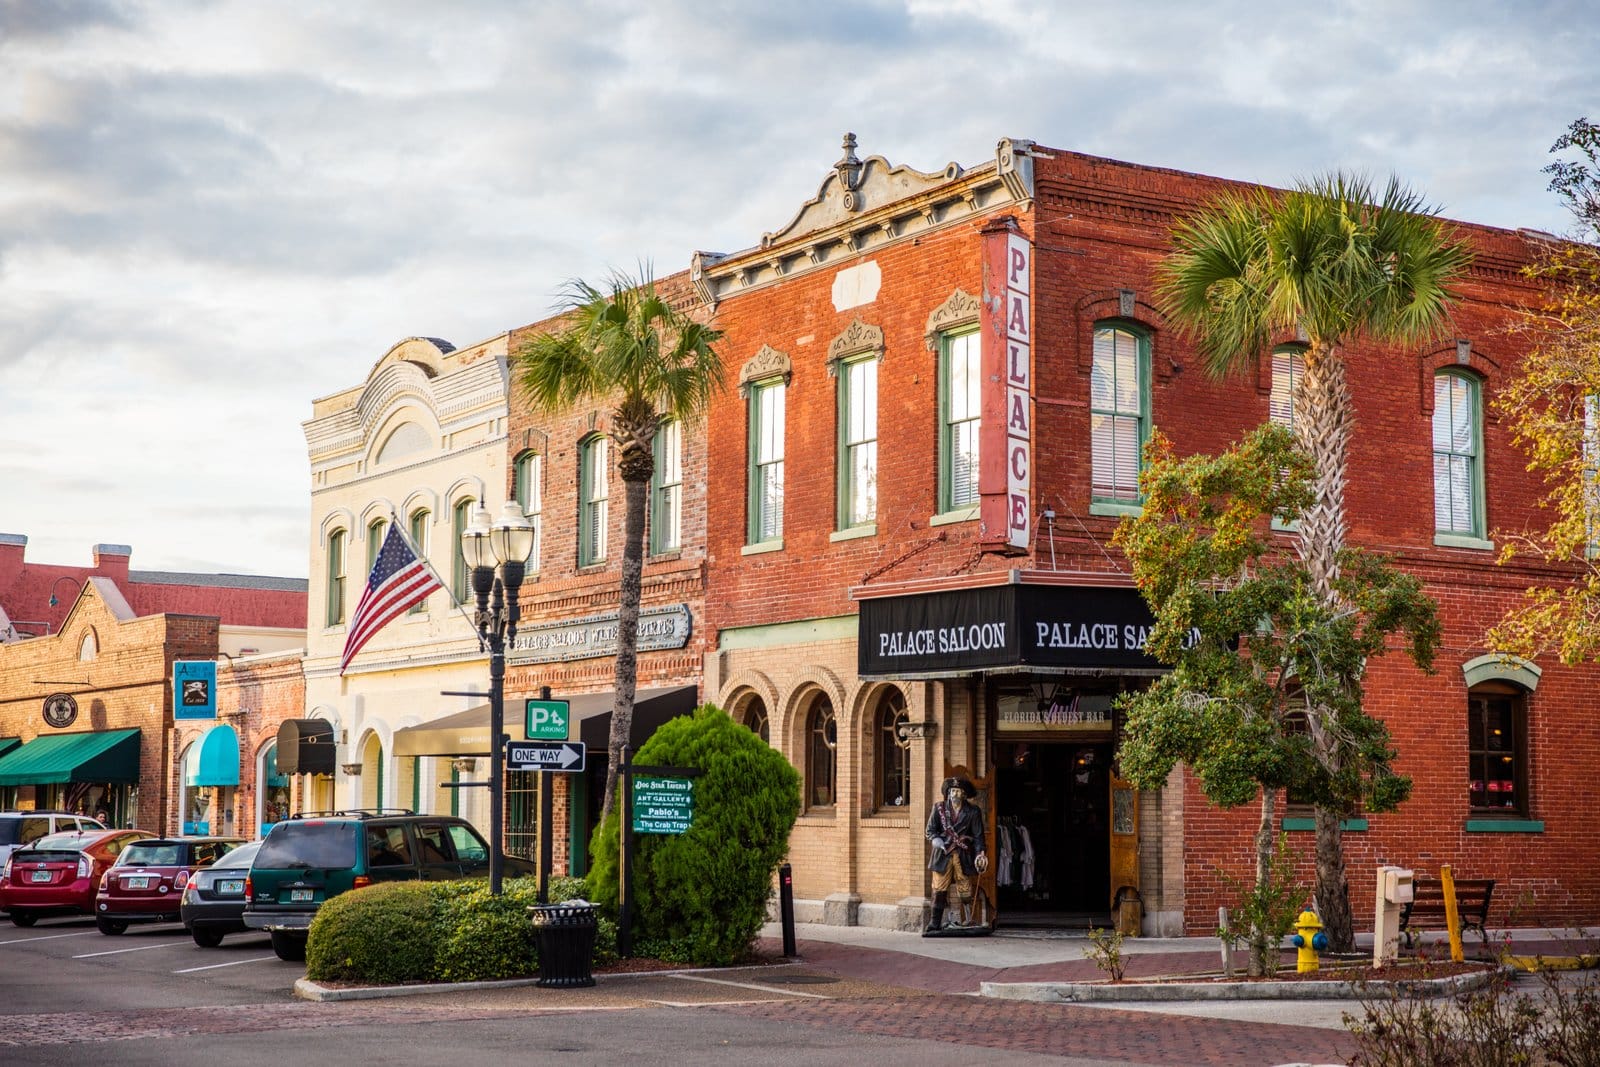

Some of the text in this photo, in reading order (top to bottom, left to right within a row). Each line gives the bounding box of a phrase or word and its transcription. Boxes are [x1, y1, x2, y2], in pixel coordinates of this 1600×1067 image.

[1010, 247, 1027, 532] PALACE
[515, 634, 548, 652] PALACE
[550, 630, 587, 648] SALOON
[879, 622, 1006, 656] PALACE SALOON
[1036, 622, 1119, 649] PALACE
[1004, 712, 1105, 725] FLORIDA'S OLDEST BAR
[515, 750, 561, 762] ONE WAY
[648, 807, 679, 816] Pablo's
[640, 820, 653, 828] The
[672, 821, 688, 829] Trap
